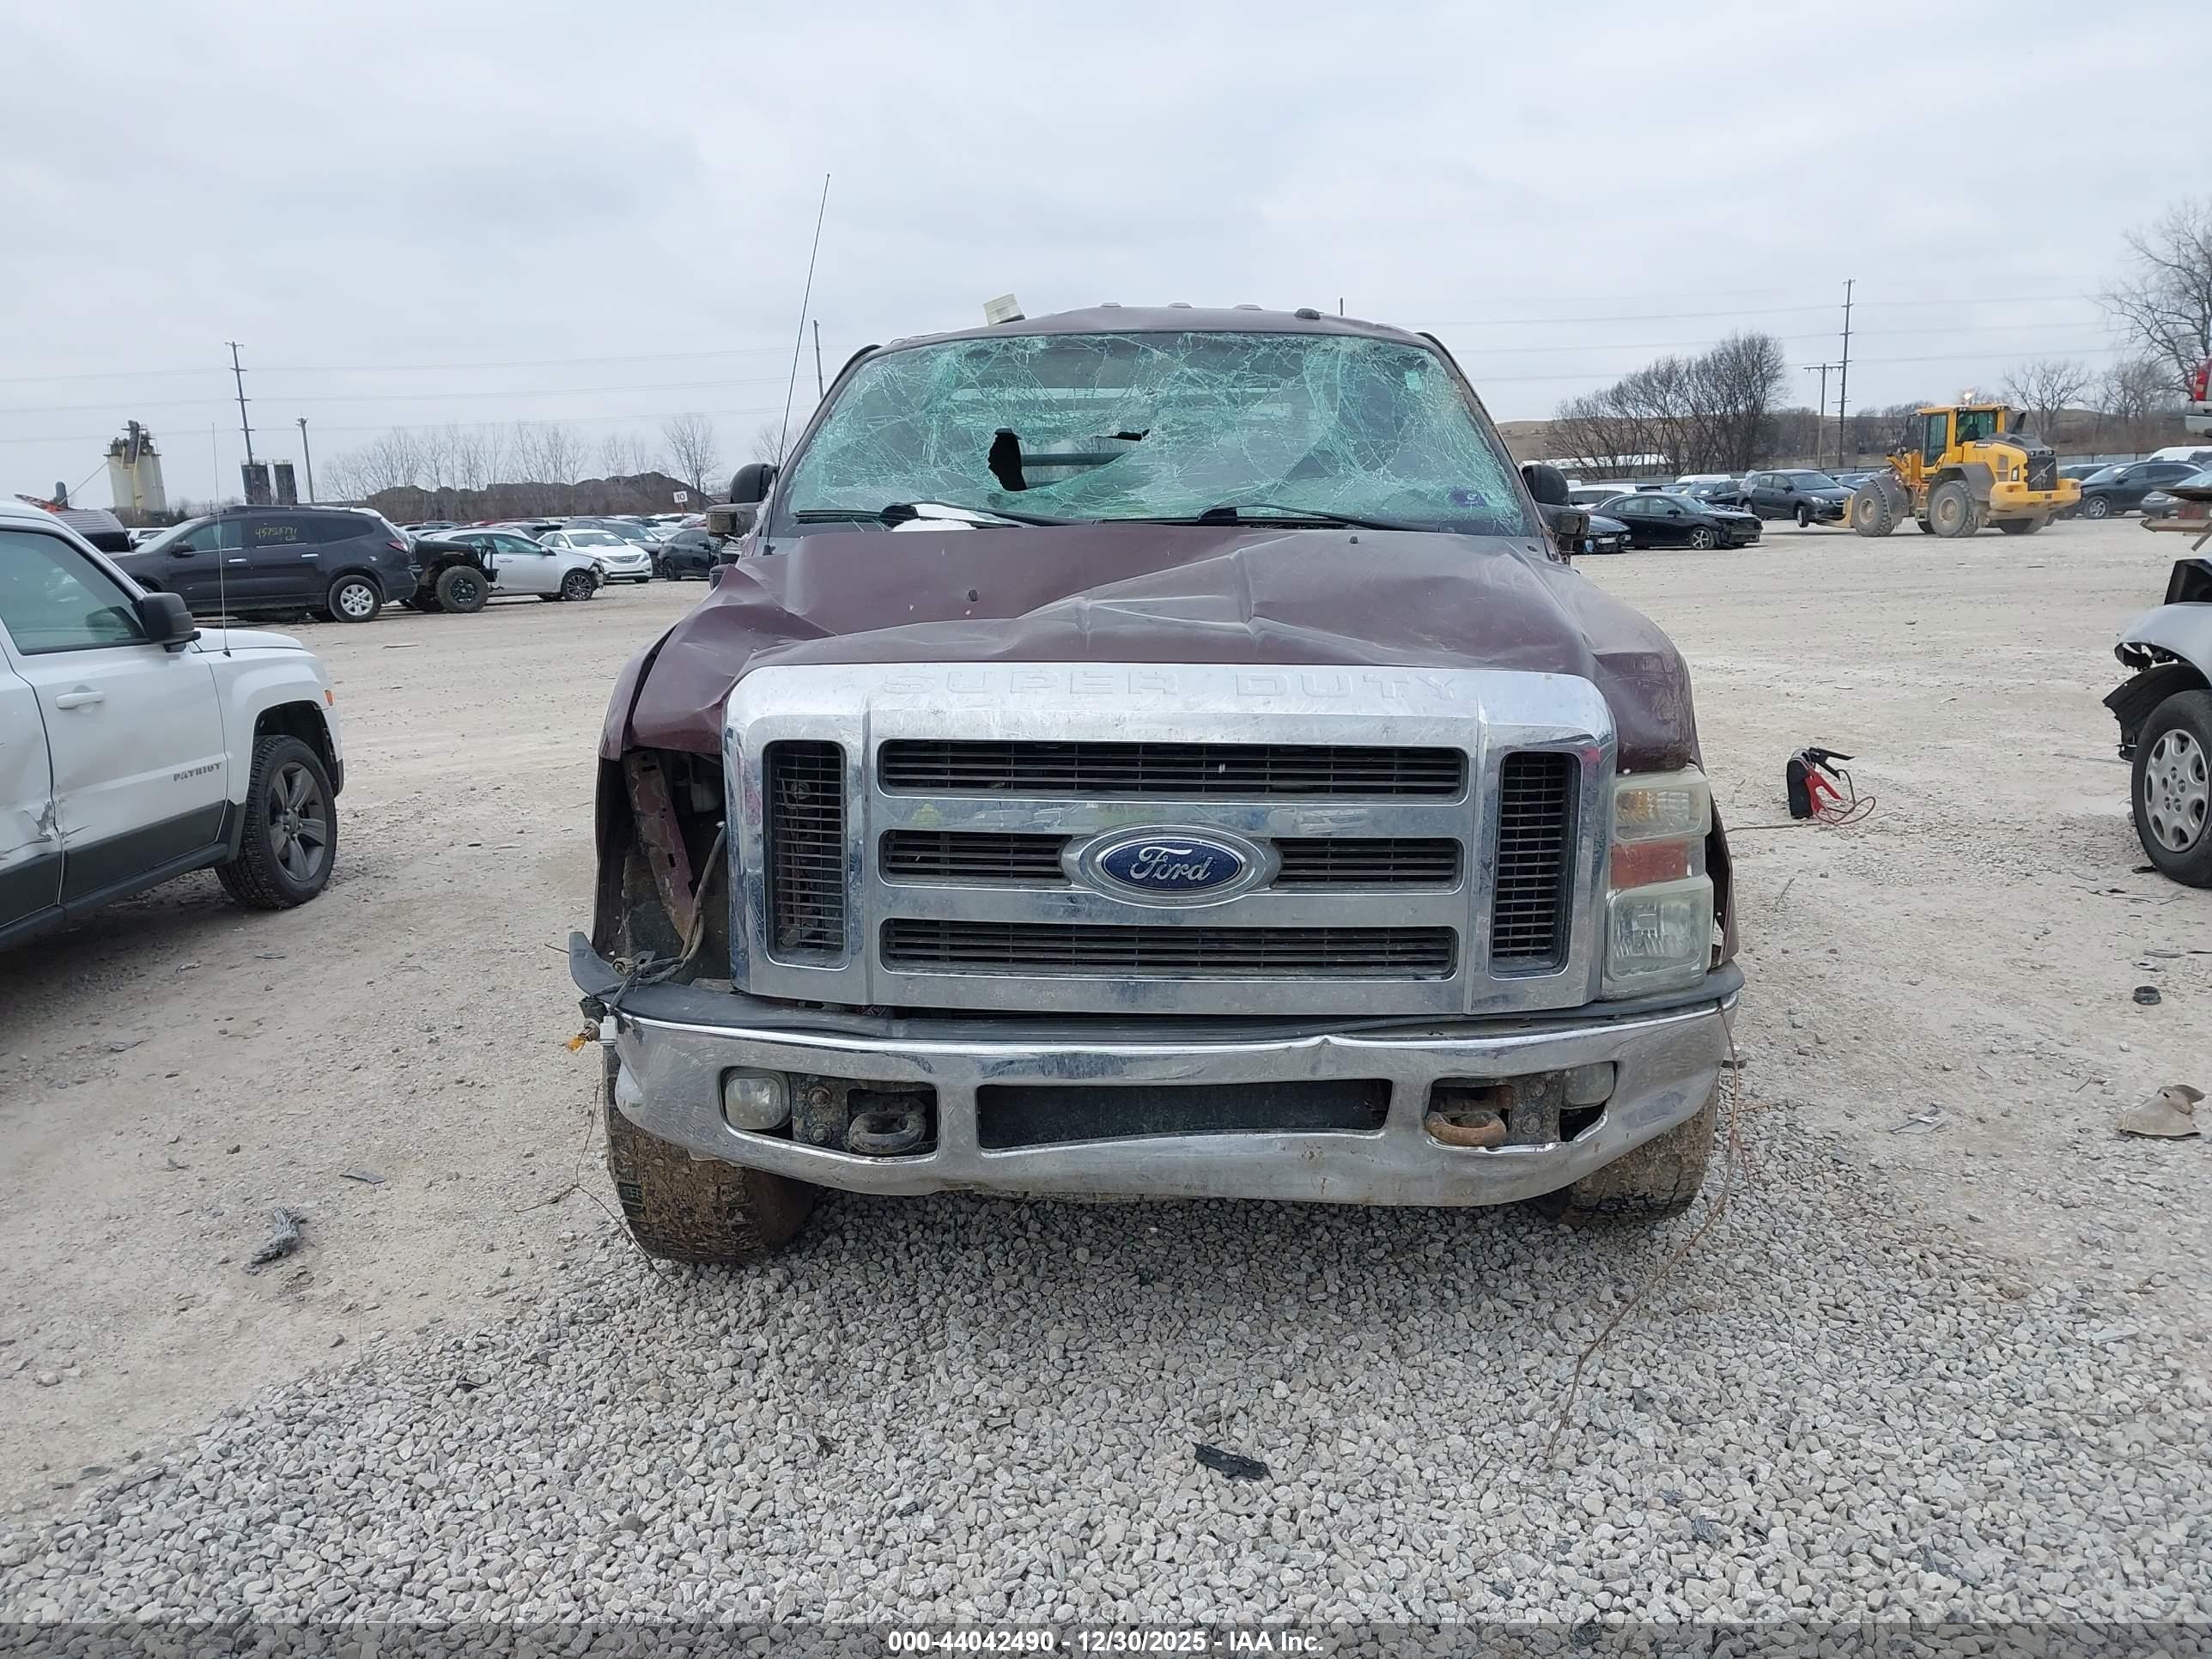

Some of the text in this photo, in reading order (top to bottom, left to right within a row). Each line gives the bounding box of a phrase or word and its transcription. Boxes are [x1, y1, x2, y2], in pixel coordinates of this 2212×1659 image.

[677, 493, 685, 502] 10
[881, 669, 1456, 701] SUPER DUTY
[173, 762, 222, 781] PATRIOT
[1129, 846, 1213, 881] Ford
